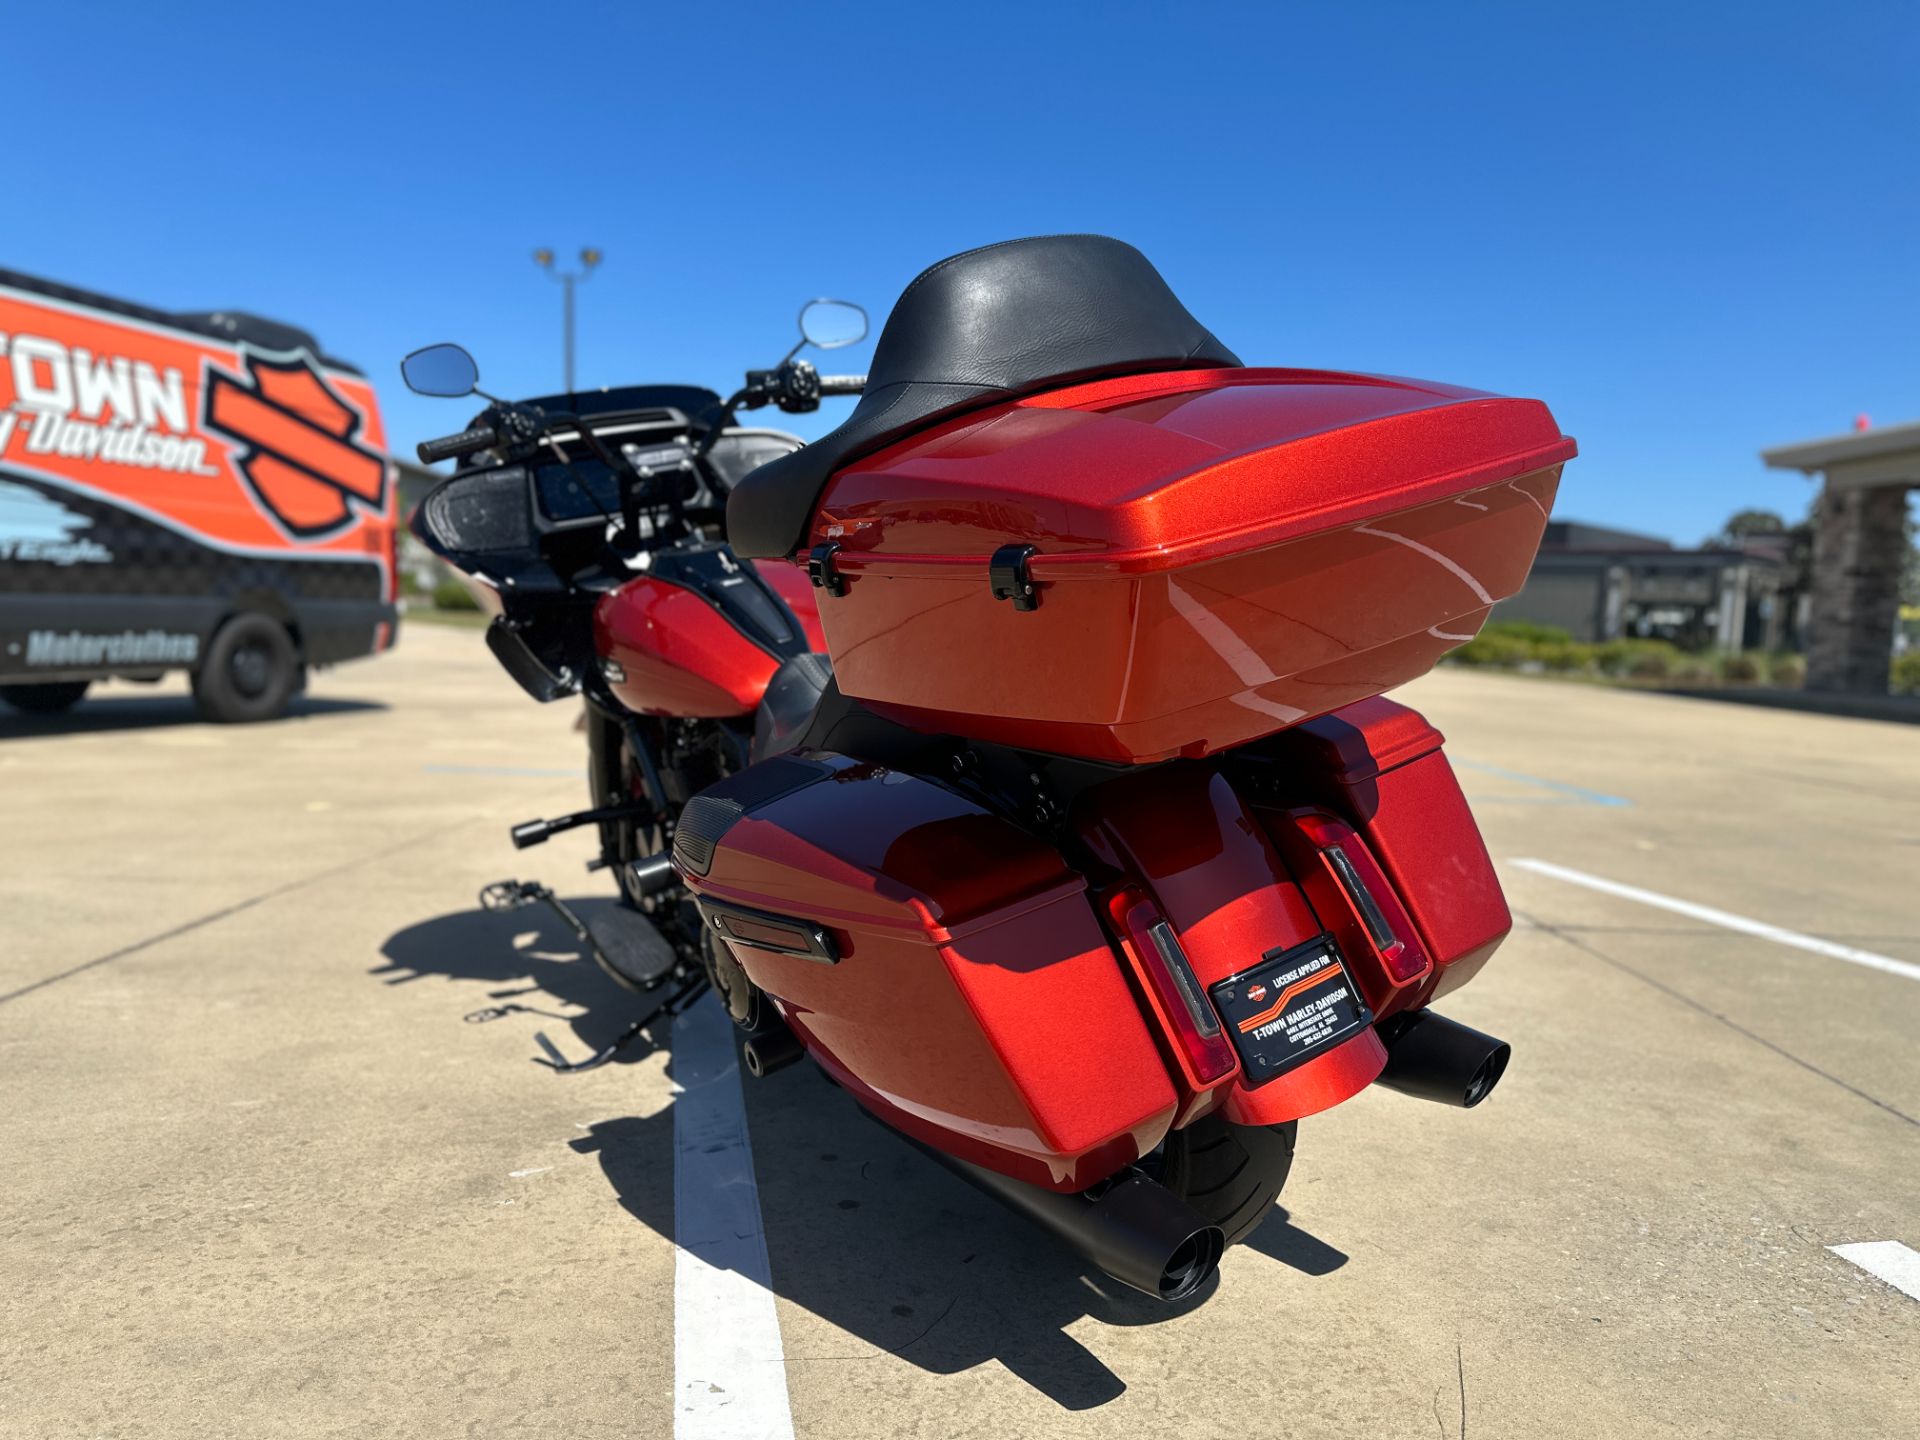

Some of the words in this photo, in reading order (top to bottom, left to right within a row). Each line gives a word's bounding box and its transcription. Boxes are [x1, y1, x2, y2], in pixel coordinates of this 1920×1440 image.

[0, 331, 189, 433] OWN
[1272, 970, 1299, 989] LICENSE
[1297, 959, 1321, 977] APPLIED
[1319, 954, 1331, 966] FOR
[1252, 1018, 1287, 1041] T-TOWN
[1286, 987, 1348, 1025] HARLEY-DAVIDSON
